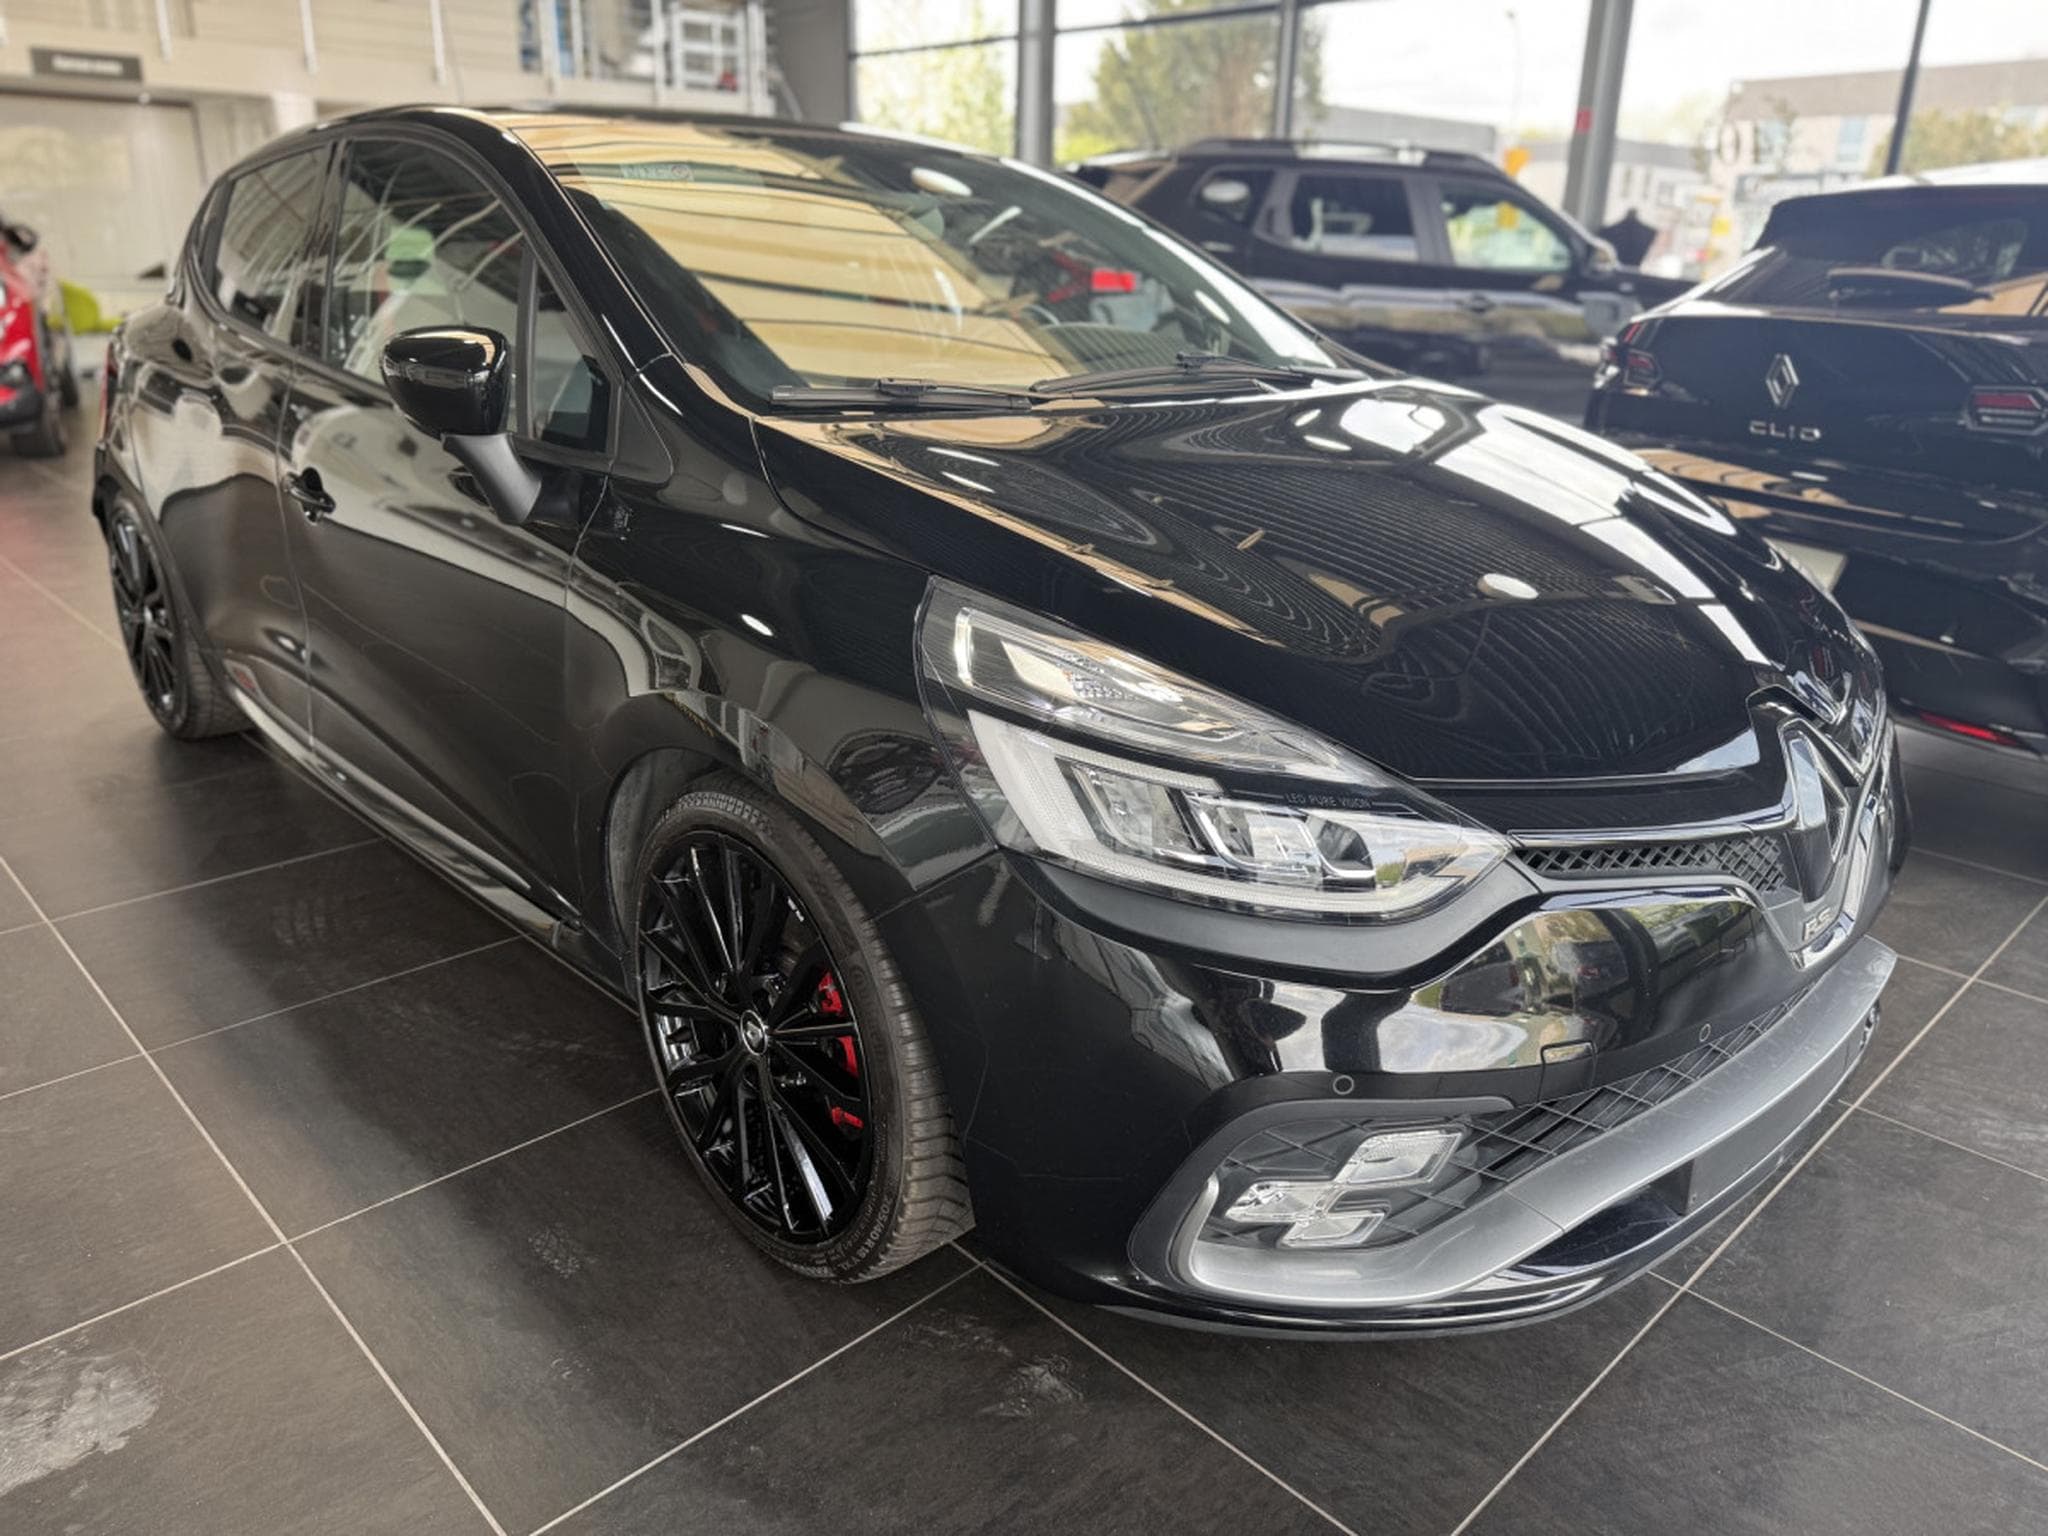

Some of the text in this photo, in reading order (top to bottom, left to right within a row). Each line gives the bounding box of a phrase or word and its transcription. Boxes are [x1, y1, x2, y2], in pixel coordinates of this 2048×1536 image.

[1749, 420, 1822, 442] CLIO
[1285, 792, 1306, 804] LED
[1308, 794, 1337, 808] PURE
